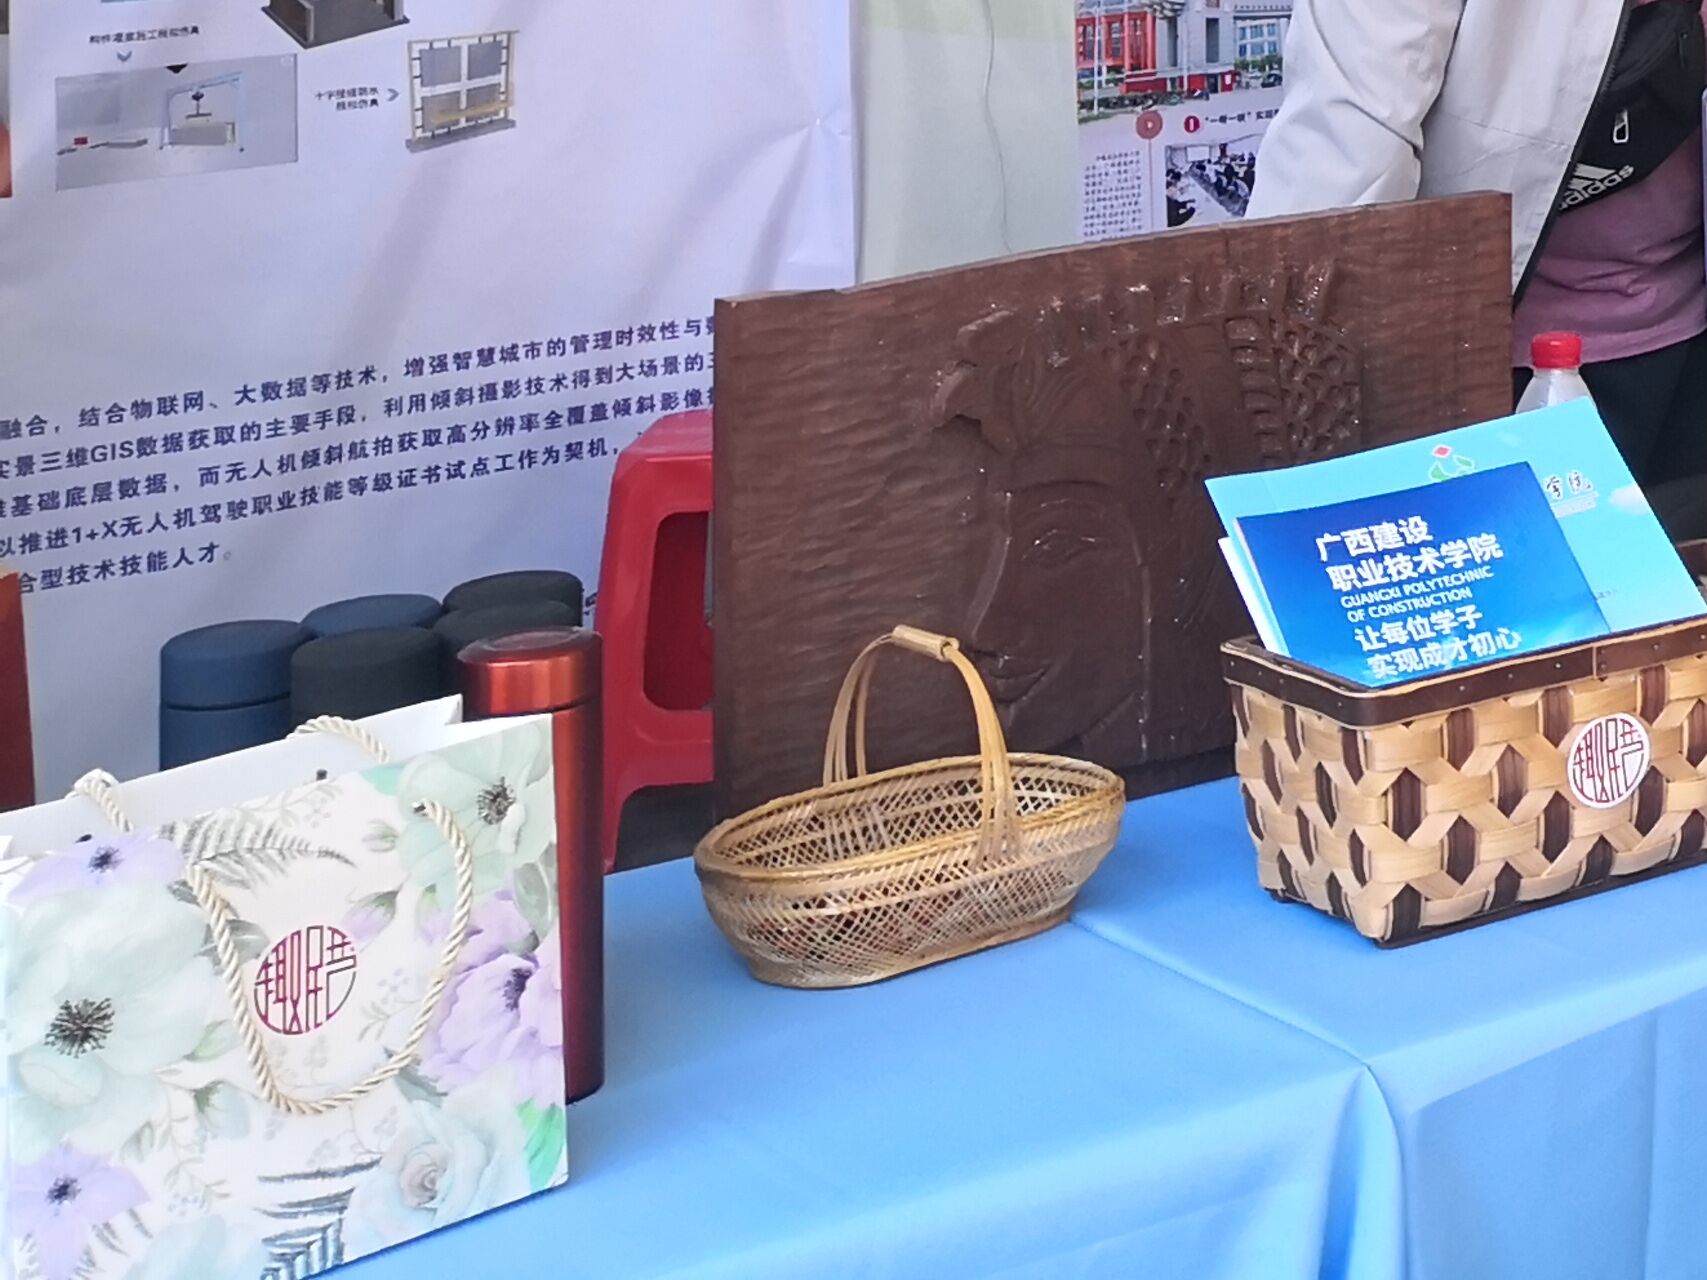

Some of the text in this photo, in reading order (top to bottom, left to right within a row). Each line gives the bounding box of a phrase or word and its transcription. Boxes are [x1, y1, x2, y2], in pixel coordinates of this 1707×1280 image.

[1315, 515, 1435, 563] 广西建设
[1325, 531, 1505, 593] 职业技术学院
[1339, 565, 1495, 609] GUANGXI POLYTECHNIC
[1346, 587, 1474, 623] OF CONSTRUCTION
[1354, 603, 1484, 654] 让每位学子
[1365, 627, 1523, 680] 实现成才初心
